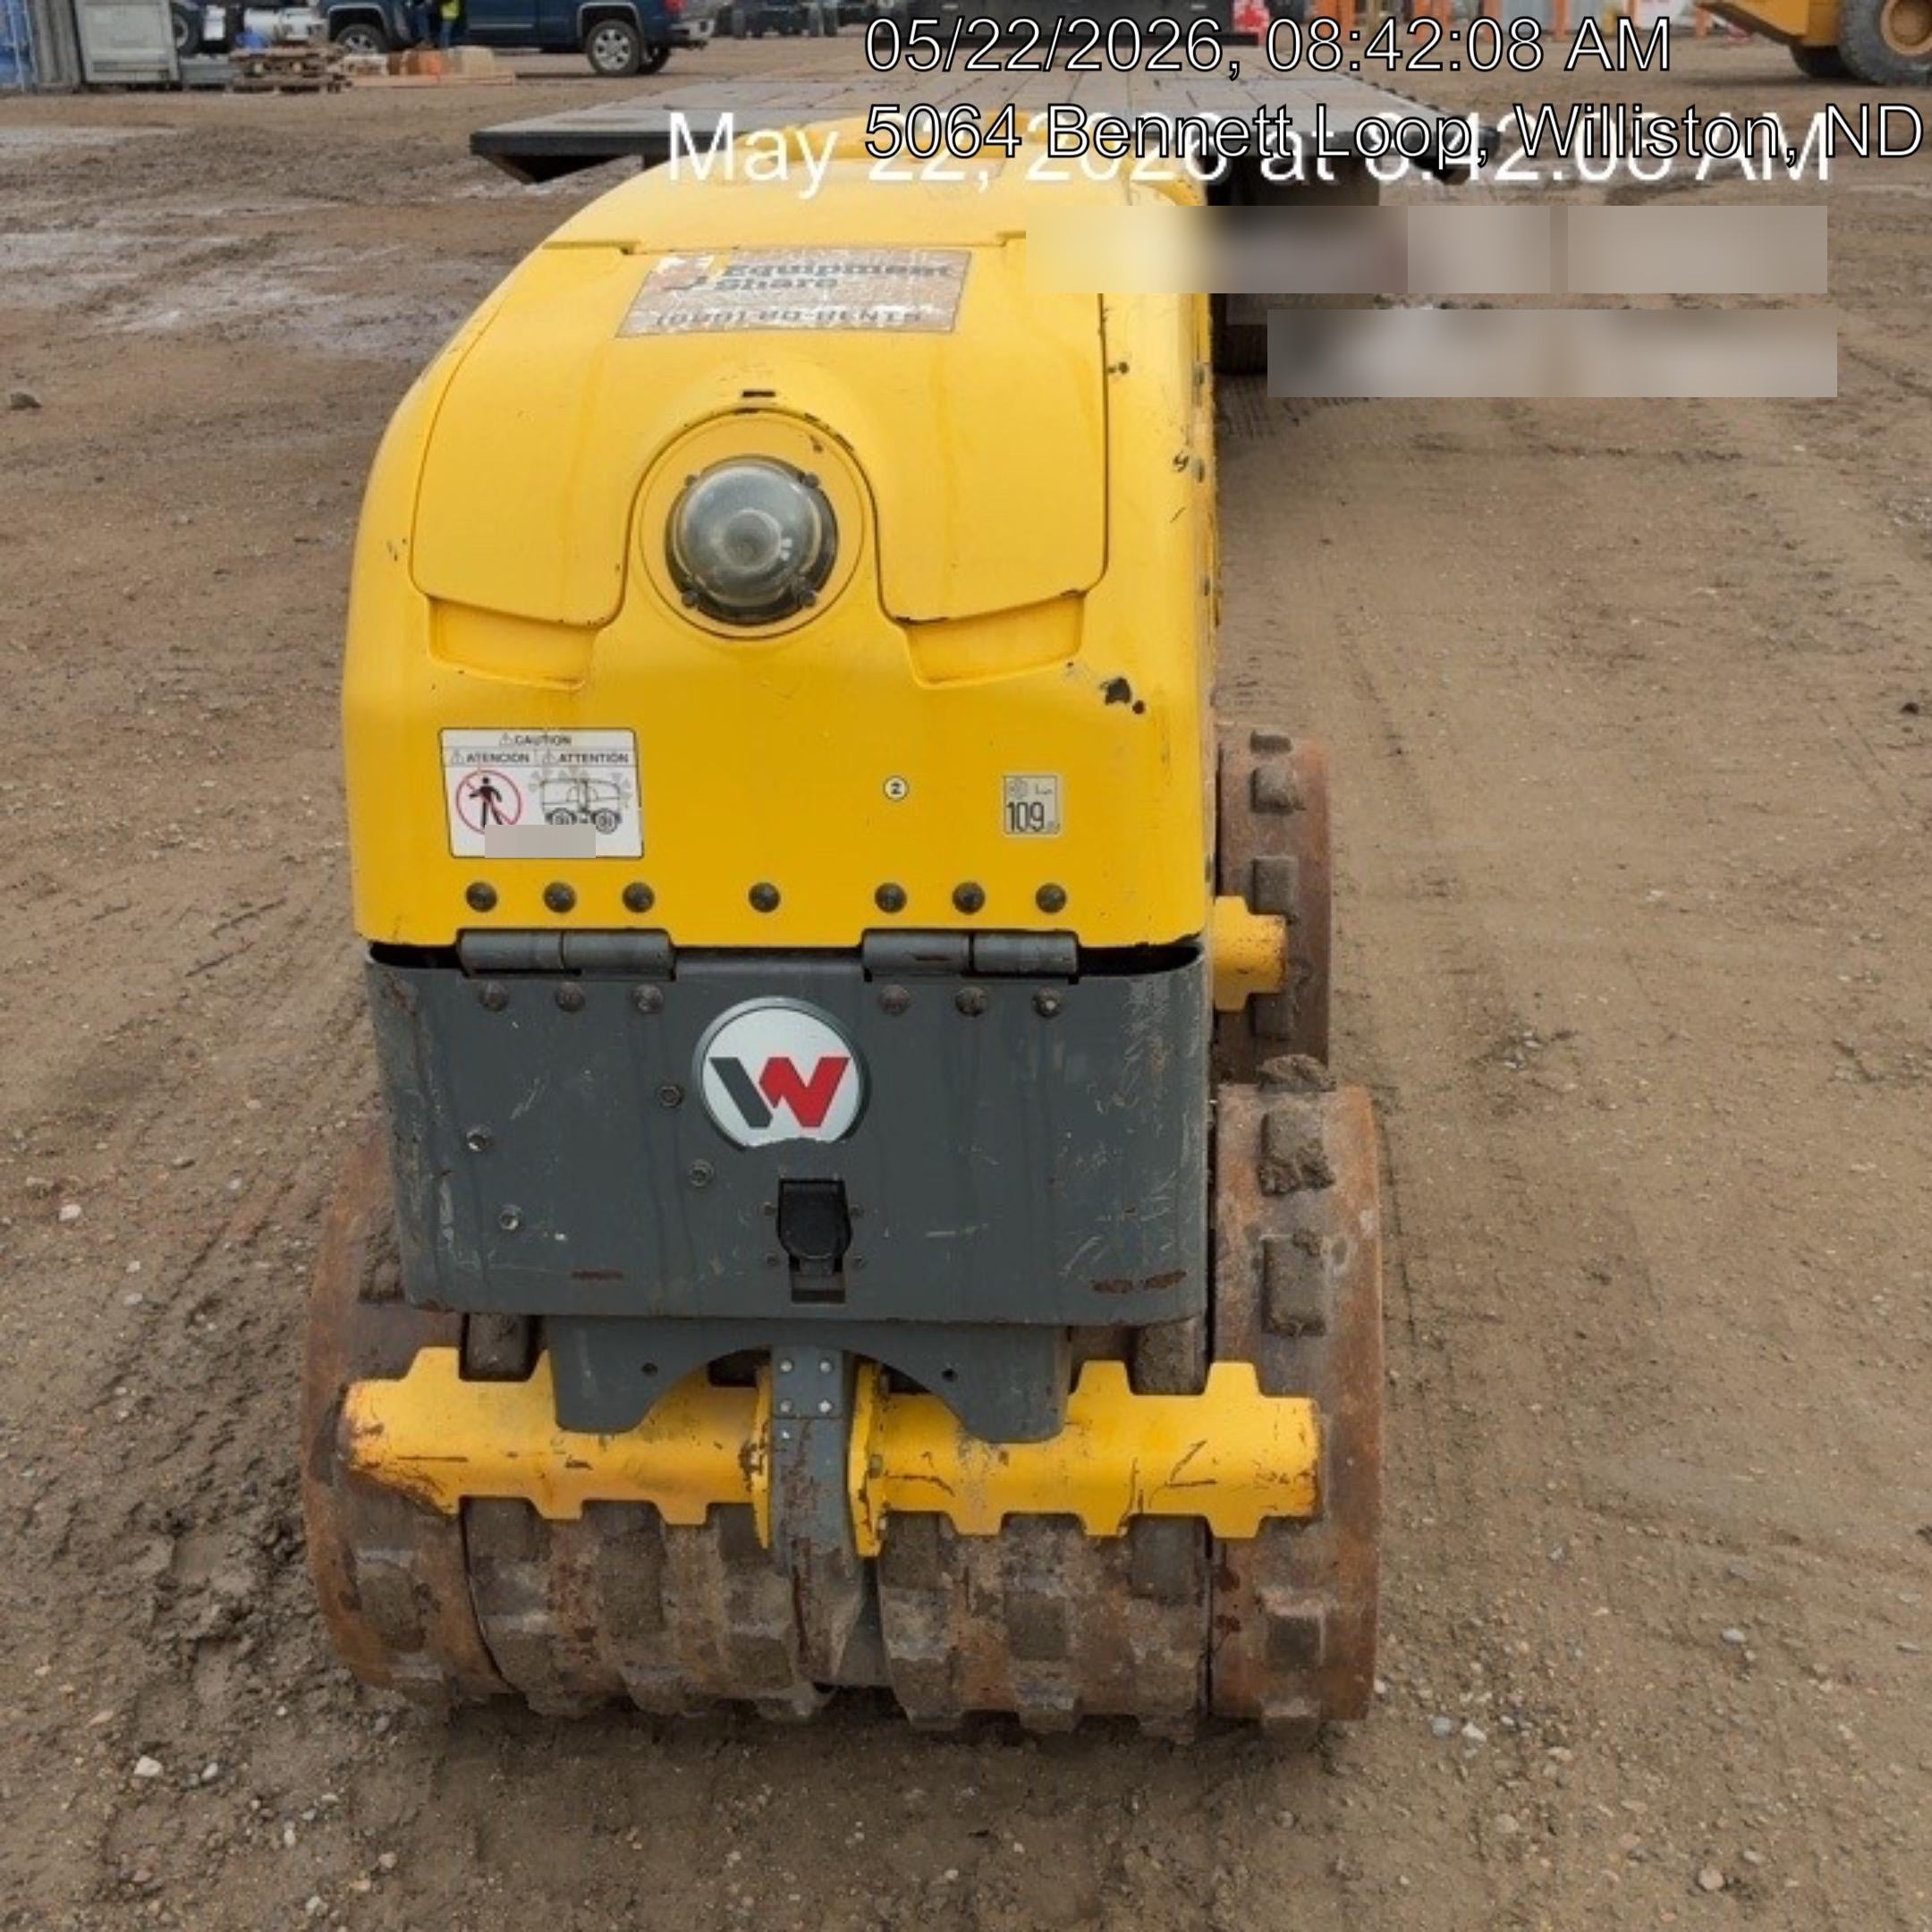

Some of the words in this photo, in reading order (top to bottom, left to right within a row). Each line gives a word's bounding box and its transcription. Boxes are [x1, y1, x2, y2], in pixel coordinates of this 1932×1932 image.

[714, 277, 838, 292] Share
[514, 734, 572, 745] CAUTION
[559, 752, 630, 764] ATTENTION
[1006, 801, 1045, 833] 109
